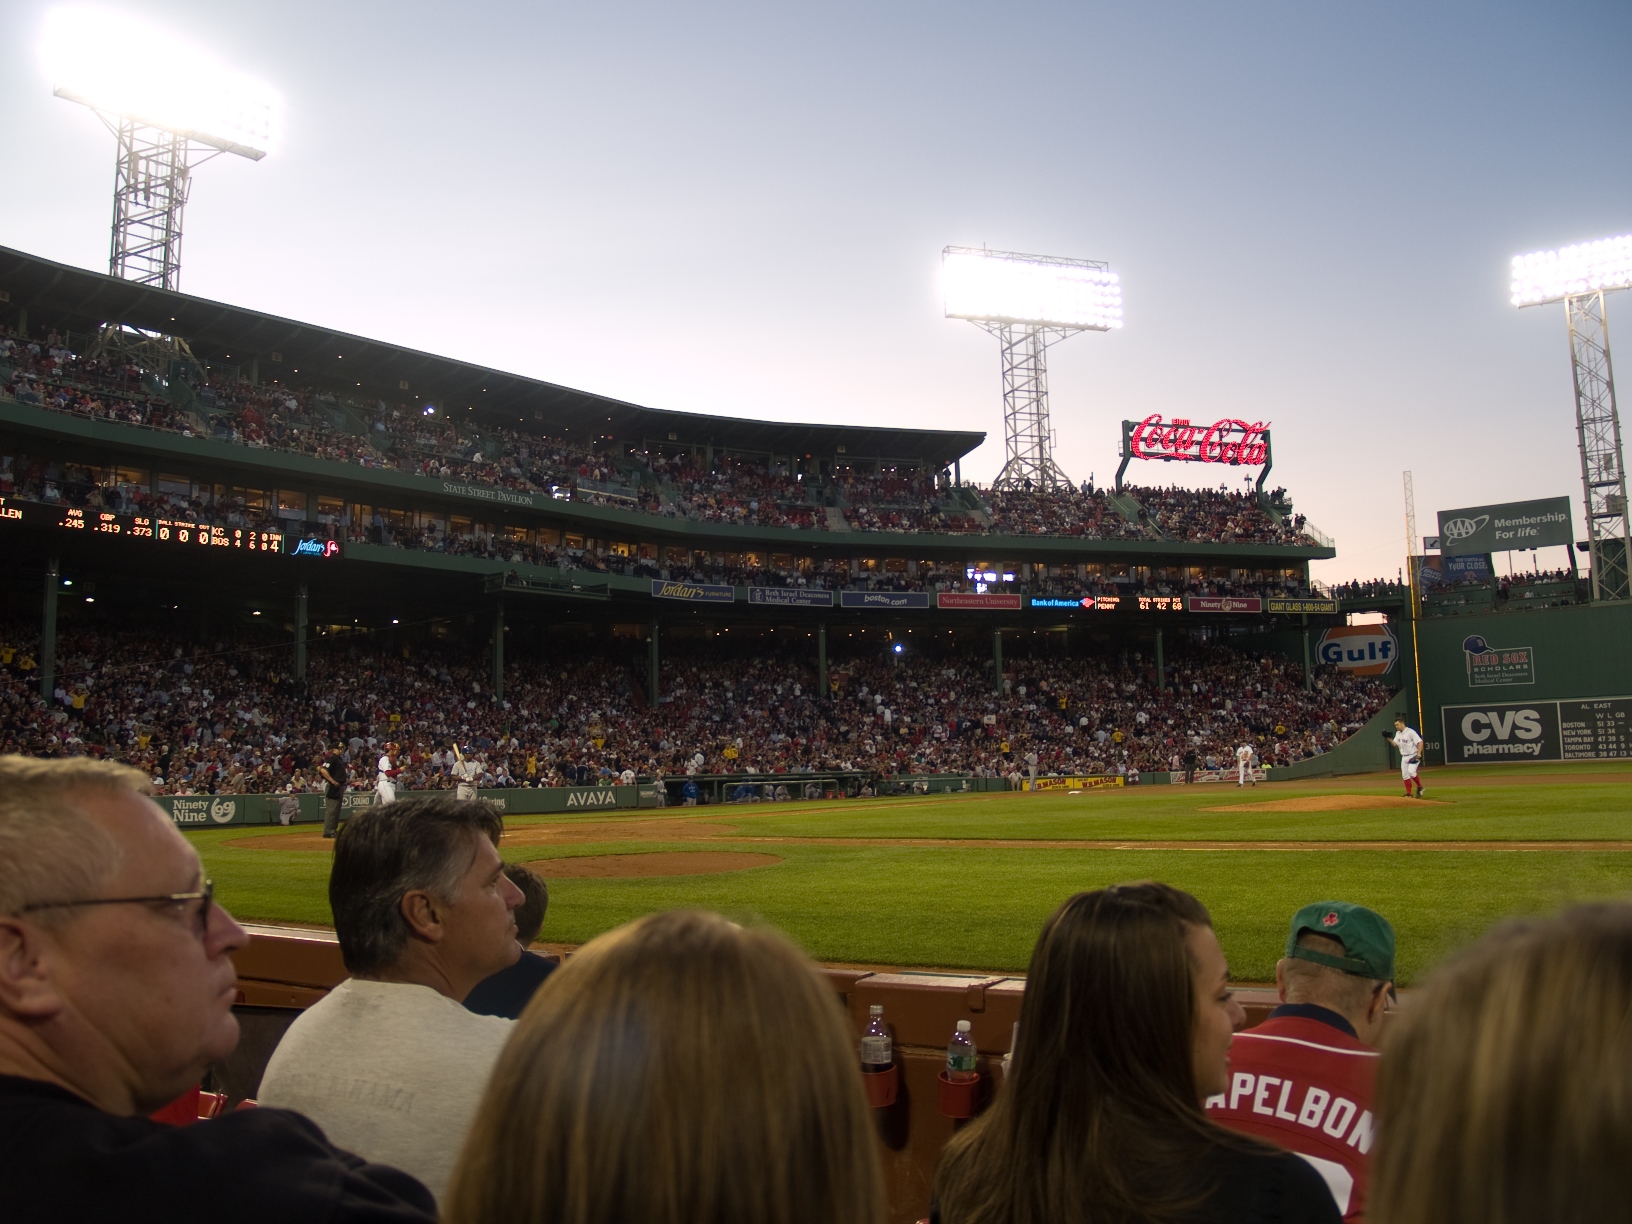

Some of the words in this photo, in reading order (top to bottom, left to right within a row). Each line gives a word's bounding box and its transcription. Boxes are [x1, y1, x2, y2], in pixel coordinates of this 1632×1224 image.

[443, 482, 466, 495] STATE
[468, 486, 495, 499] STREET
[498, 490, 533, 506] PAVILION
[68, 508, 83, 517] AVG
[100, 513, 115, 521] OBP
[1494, 512, 1568, 528] Membership.
[59, 518, 85, 529] .245
[94, 523, 120, 533] .319
[127, 527, 152, 537] .373
[1448, 519, 1473, 538] AAA
[160, 528, 169, 540] 0
[179, 530, 188, 542] 0
[199, 532, 208, 544] 0
[212, 528, 224, 536] KC
[235, 530, 241, 538] 0
[250, 532, 256, 540] 2
[270, 534, 281, 542] INN
[1495, 530, 1514, 540] For
[212, 536, 229, 546] BOS
[235, 540, 241, 548] 4
[249, 541, 256, 549] 6
[261, 542, 268, 550] 0
[270, 541, 279, 552] 4
[290, 538, 325, 556] Jordan's
[1423, 569, 1442, 577] BUD
[659, 582, 704, 598] Jordan's
[781, 590, 798, 598] Israel
[800, 591, 830, 599] Deaconess
[864, 594, 907, 606] boston.com
[942, 596, 984, 605] Northeastern
[985, 597, 1017, 607] University
[1140, 602, 1149, 610] 61
[1157, 602, 1166, 610] 42
[1200, 601, 1220, 609] Ninety
[1271, 602, 1285, 611] GIANT
[1286, 602, 1301, 611] GLASS
[1322, 640, 1391, 662] Gulf
[1473, 654, 1498, 666] RED
[1503, 652, 1528, 664] SOX
[1474, 664, 1528, 672] SCHOLARS
[1462, 709, 1542, 742] CVS
[1425, 742, 1440, 750] 310
[1464, 742, 1542, 758] pharmacy
[353, 797, 370, 805] SOUND
[567, 791, 616, 806] AVAYA
[173, 800, 208, 810] Ninety
[173, 810, 207, 822] Nine
